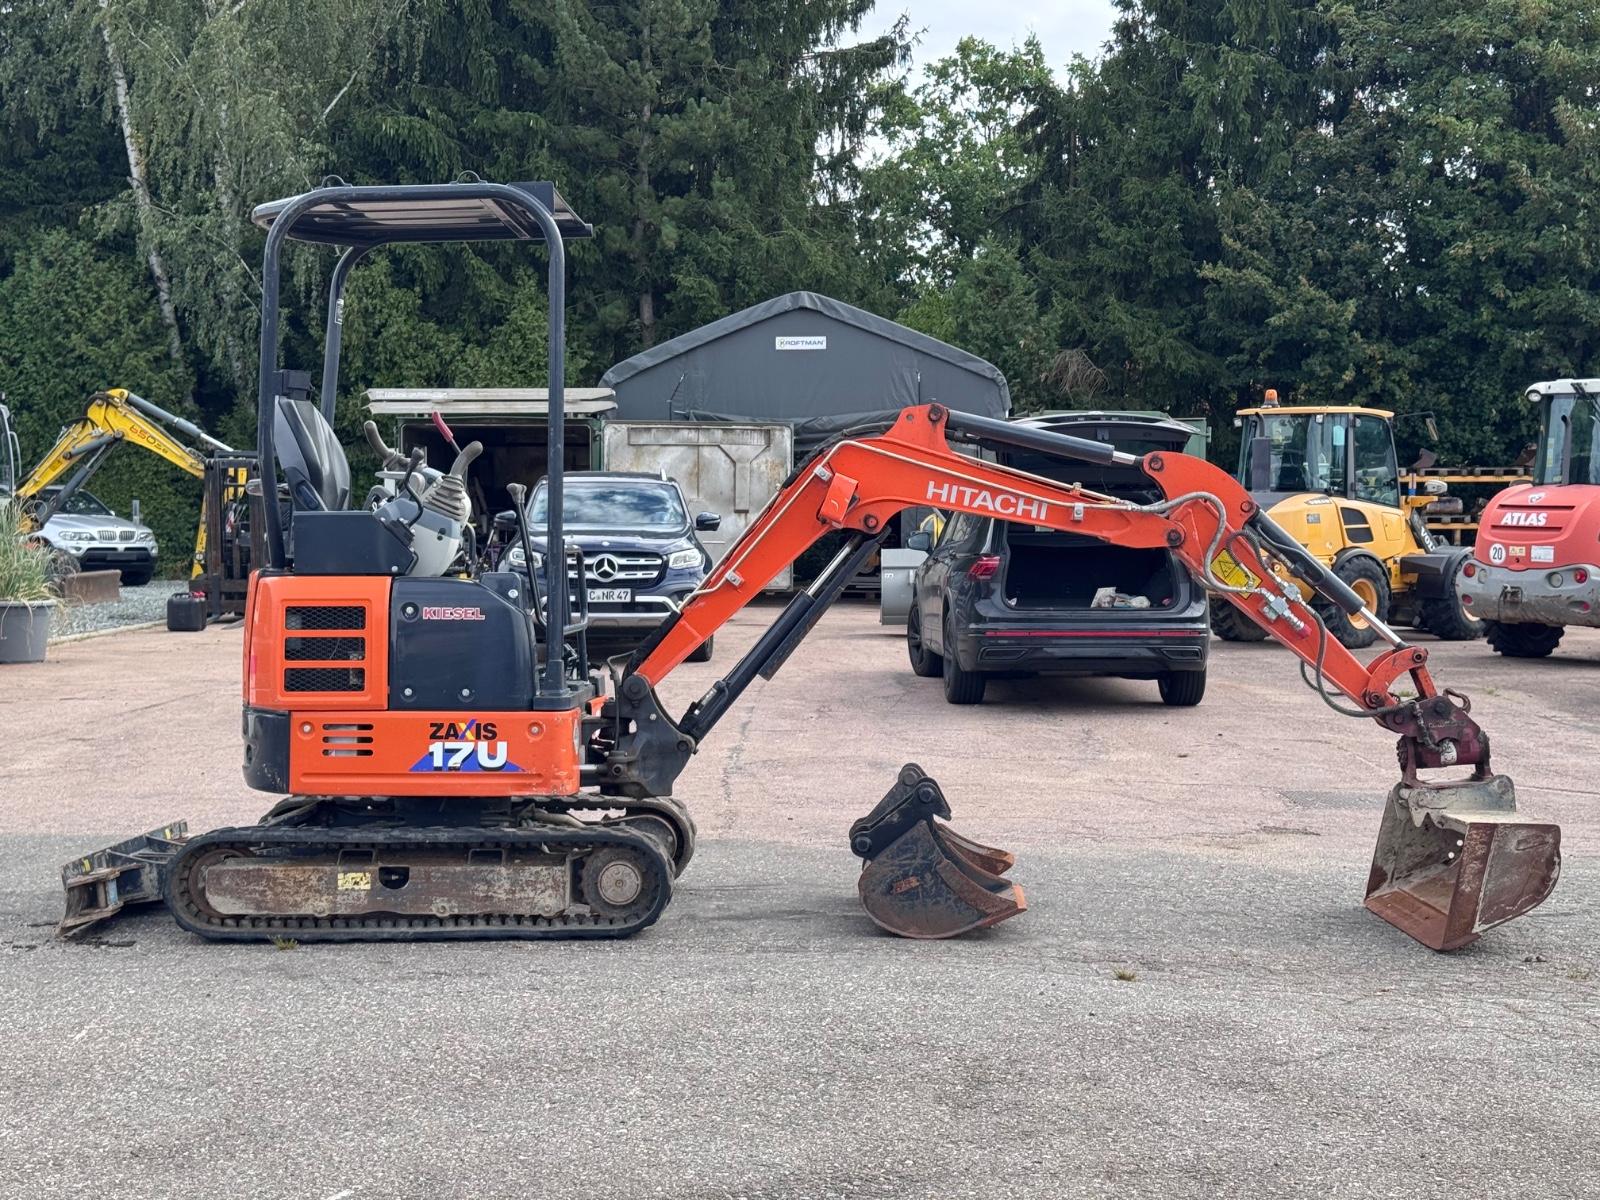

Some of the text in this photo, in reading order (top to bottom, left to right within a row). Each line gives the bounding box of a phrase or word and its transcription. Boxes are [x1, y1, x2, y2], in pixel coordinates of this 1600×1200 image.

[926, 480, 1048, 520] HITACHI
[1500, 511, 1547, 526] ATLAS
[1421, 526, 1436, 552] VOL
[1492, 546, 1503, 561] 20
[616, 590, 629, 601] 47
[422, 606, 486, 620] KIESEL
[429, 719, 498, 740] ZAXIS
[429, 741, 508, 770] 17U
